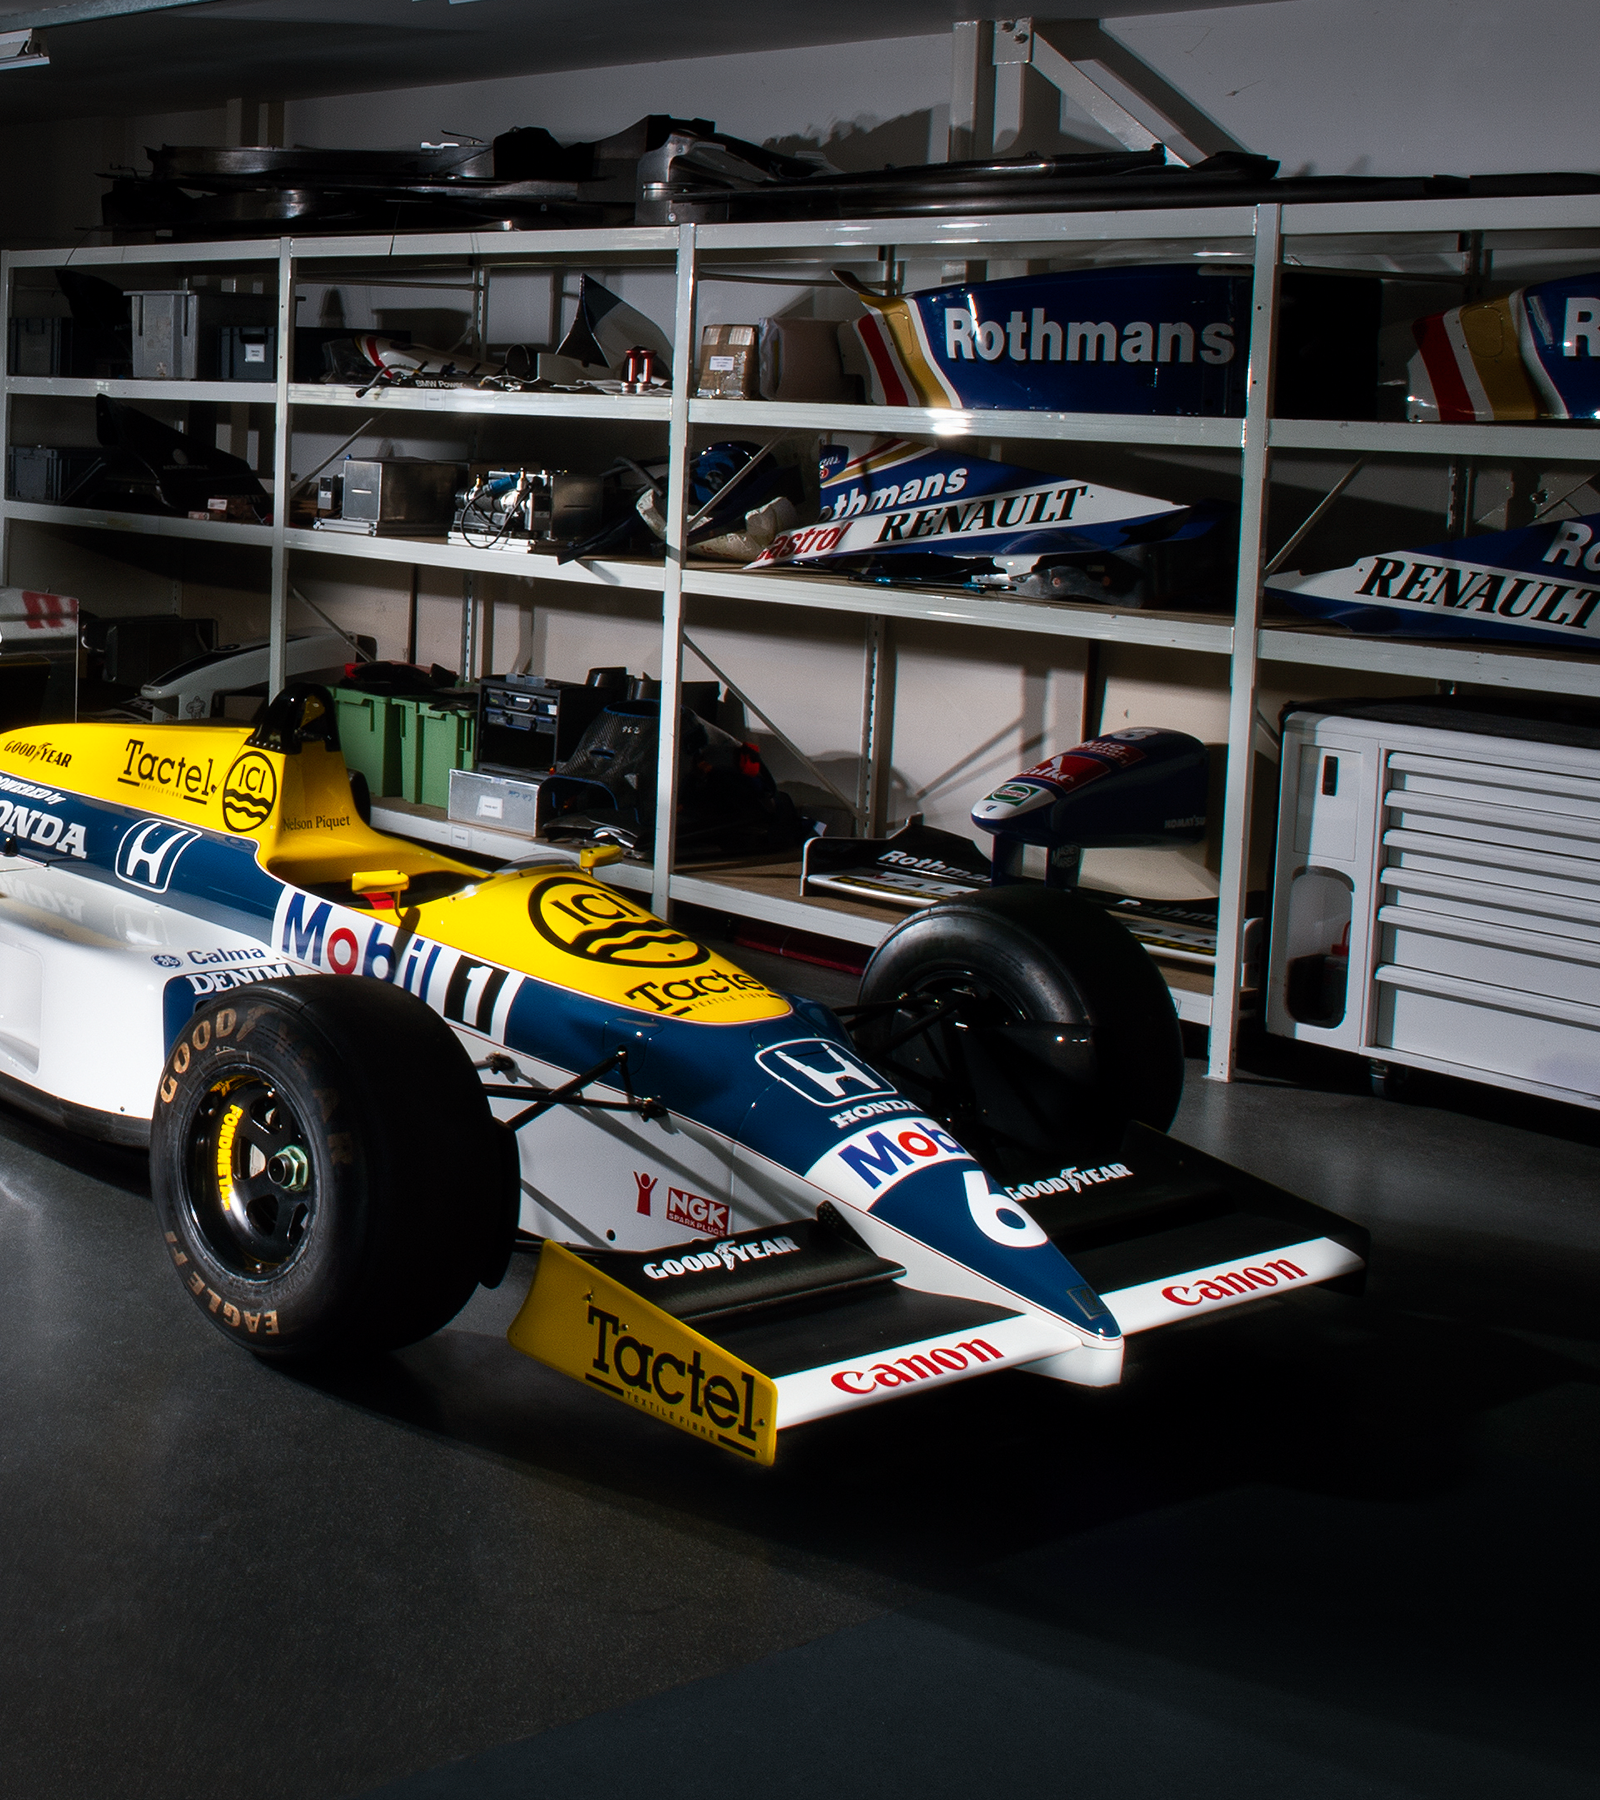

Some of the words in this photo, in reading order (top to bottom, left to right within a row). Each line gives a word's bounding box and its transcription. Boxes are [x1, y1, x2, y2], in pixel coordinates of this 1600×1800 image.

[944, 308, 1235, 365] Rothmans
[415, 379, 437, 388] BMW
[437, 379, 464, 389] Power
[818, 467, 968, 521] othmans
[874, 485, 1089, 544] RENAULT
[756, 521, 854, 562] astrol
[1354, 557, 1600, 629] RENAULT
[4, 740, 73, 768] GOODYEAR
[123, 739, 214, 796] Tactel
[238, 763, 265, 795] ICI
[283, 817, 311, 831] Nelson
[314, 814, 351, 832] Piquet
[550, 892, 640, 927] ICI
[187, 945, 267, 966] Calma
[282, 891, 442, 1005] Mobil
[464, 964, 495, 1027] 1
[185, 963, 292, 996] DENIM
[624, 969, 766, 1012] Tacte
[691, 994, 738, 1010] TEXTILE
[829, 1099, 925, 1129] HONDA
[217, 1103, 244, 1211] FONDMETAL
[837, 1121, 968, 1191] Mob
[1004, 1162, 1134, 1202] GOODYEAR
[667, 1212, 696, 1229] SPARK
[696, 1221, 726, 1237] PLUGS
[669, 1190, 729, 1229] NGK
[962, 1169, 1050, 1248] 6
[643, 1236, 801, 1280] GOODYEAR
[186, 1270, 280, 1336] EAGLE
[1161, 1257, 1309, 1306] Canon
[587, 1304, 757, 1442] Tactel
[830, 1338, 1007, 1395] Canon
[626, 1389, 675, 1421] TEXTILE
[678, 1411, 716, 1440] FIBRE
